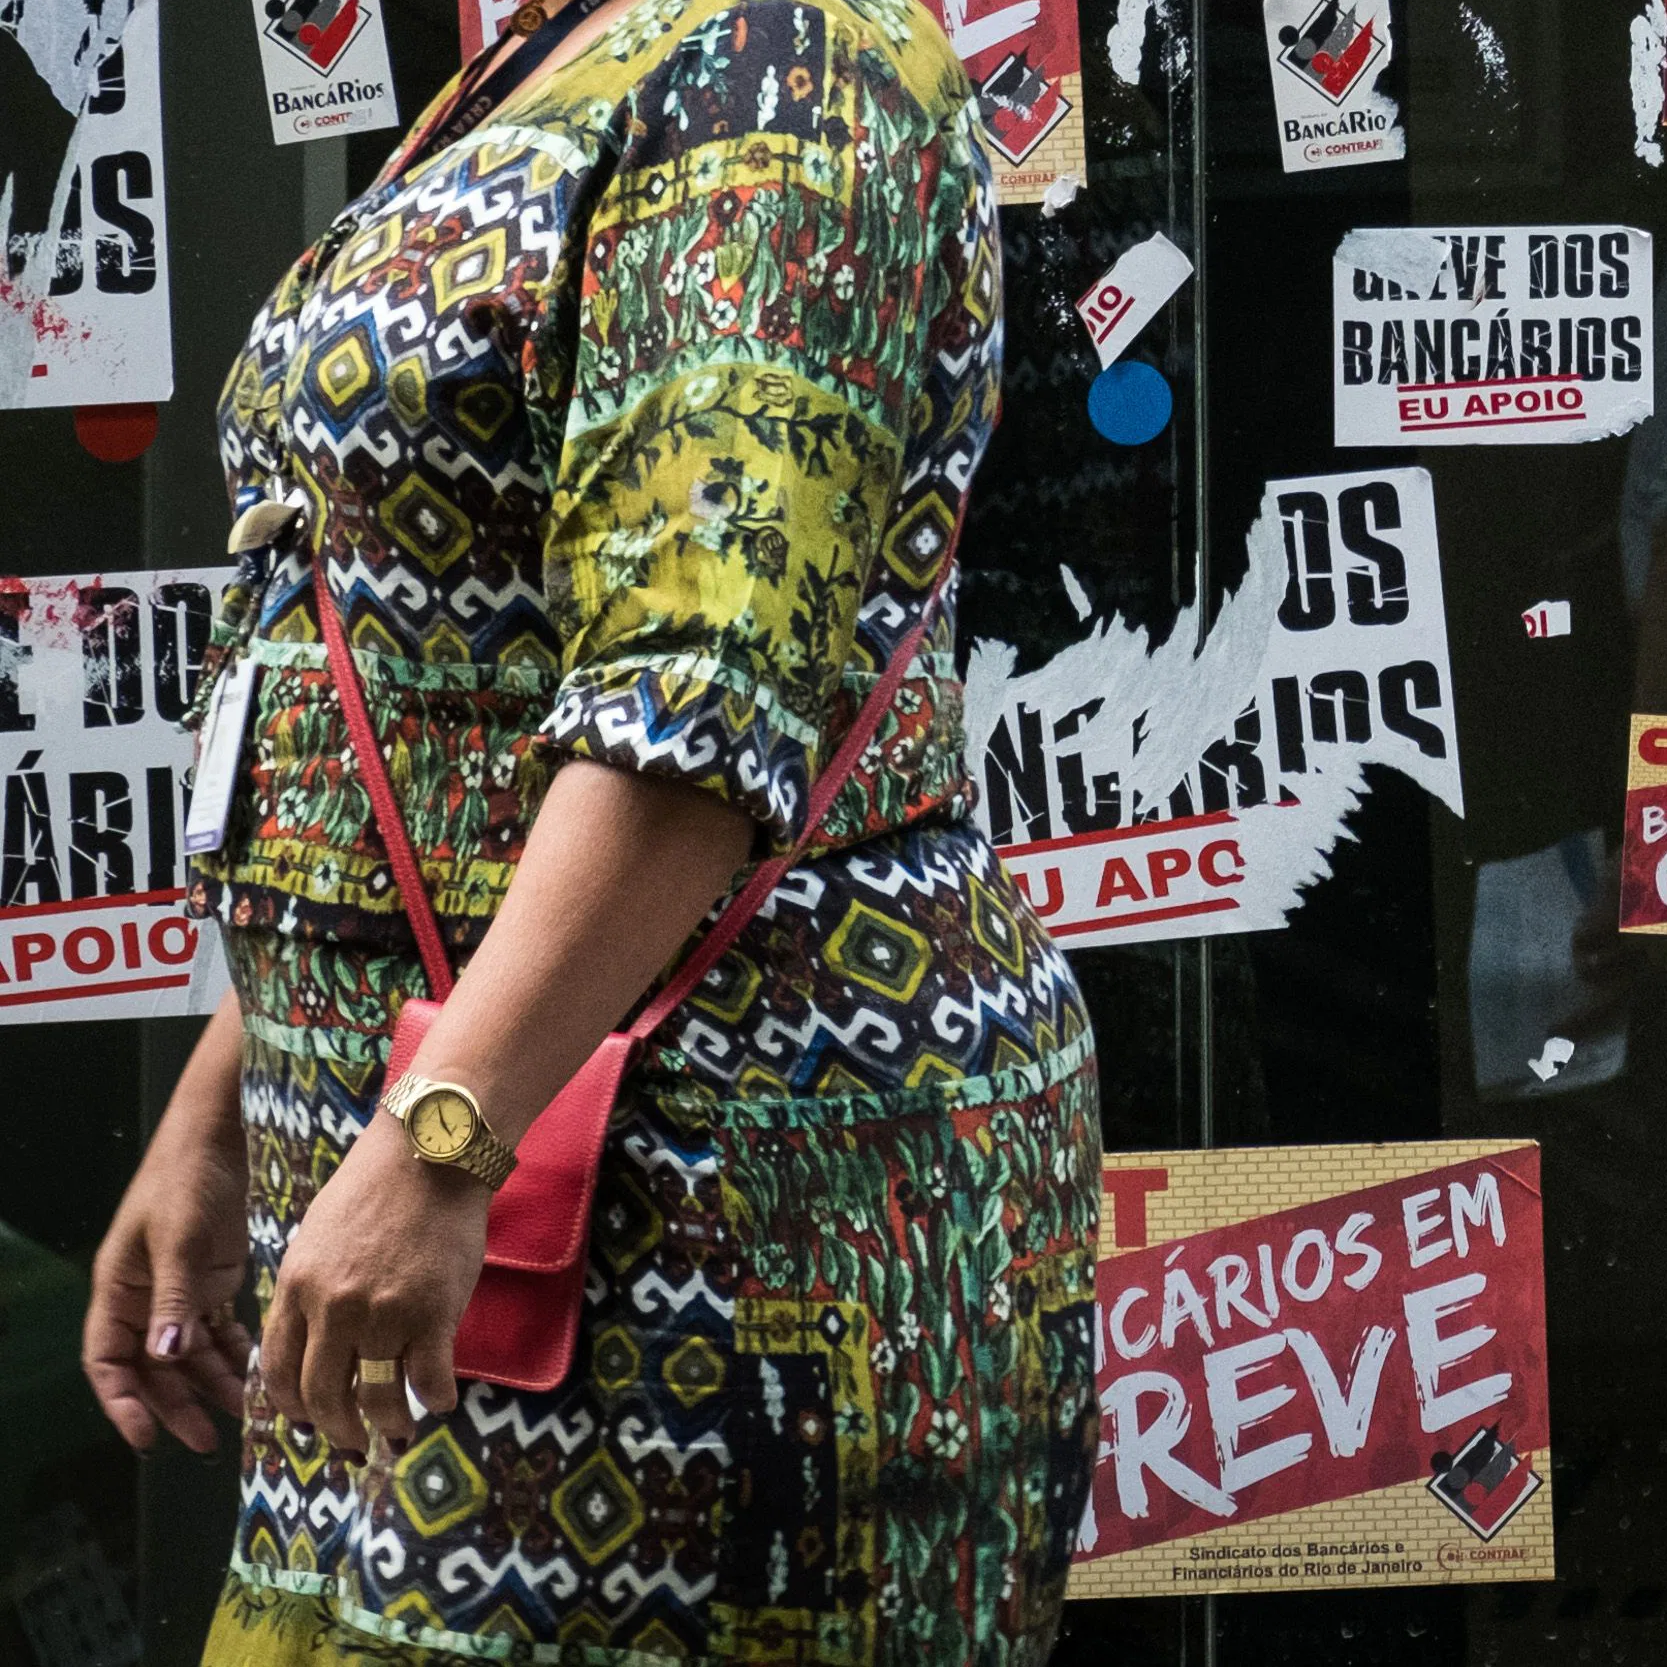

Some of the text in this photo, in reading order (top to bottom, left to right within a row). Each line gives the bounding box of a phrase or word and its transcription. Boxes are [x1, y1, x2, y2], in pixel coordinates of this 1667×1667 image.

[1529, 232, 1630, 298] DOS
[1343, 308, 1642, 385] BANCÁRIOS
[1398, 387, 1583, 421] EU APOIO
[81, 581, 216, 729] DO
[1403, 1172, 1507, 1269] EM
[1085, 1273, 1513, 1529] REVE
[1172, 1558, 1423, 1581] Financiários do Rio de Janeiro
[1190, 1540, 1405, 1561] Sindicato dos Bancários e
